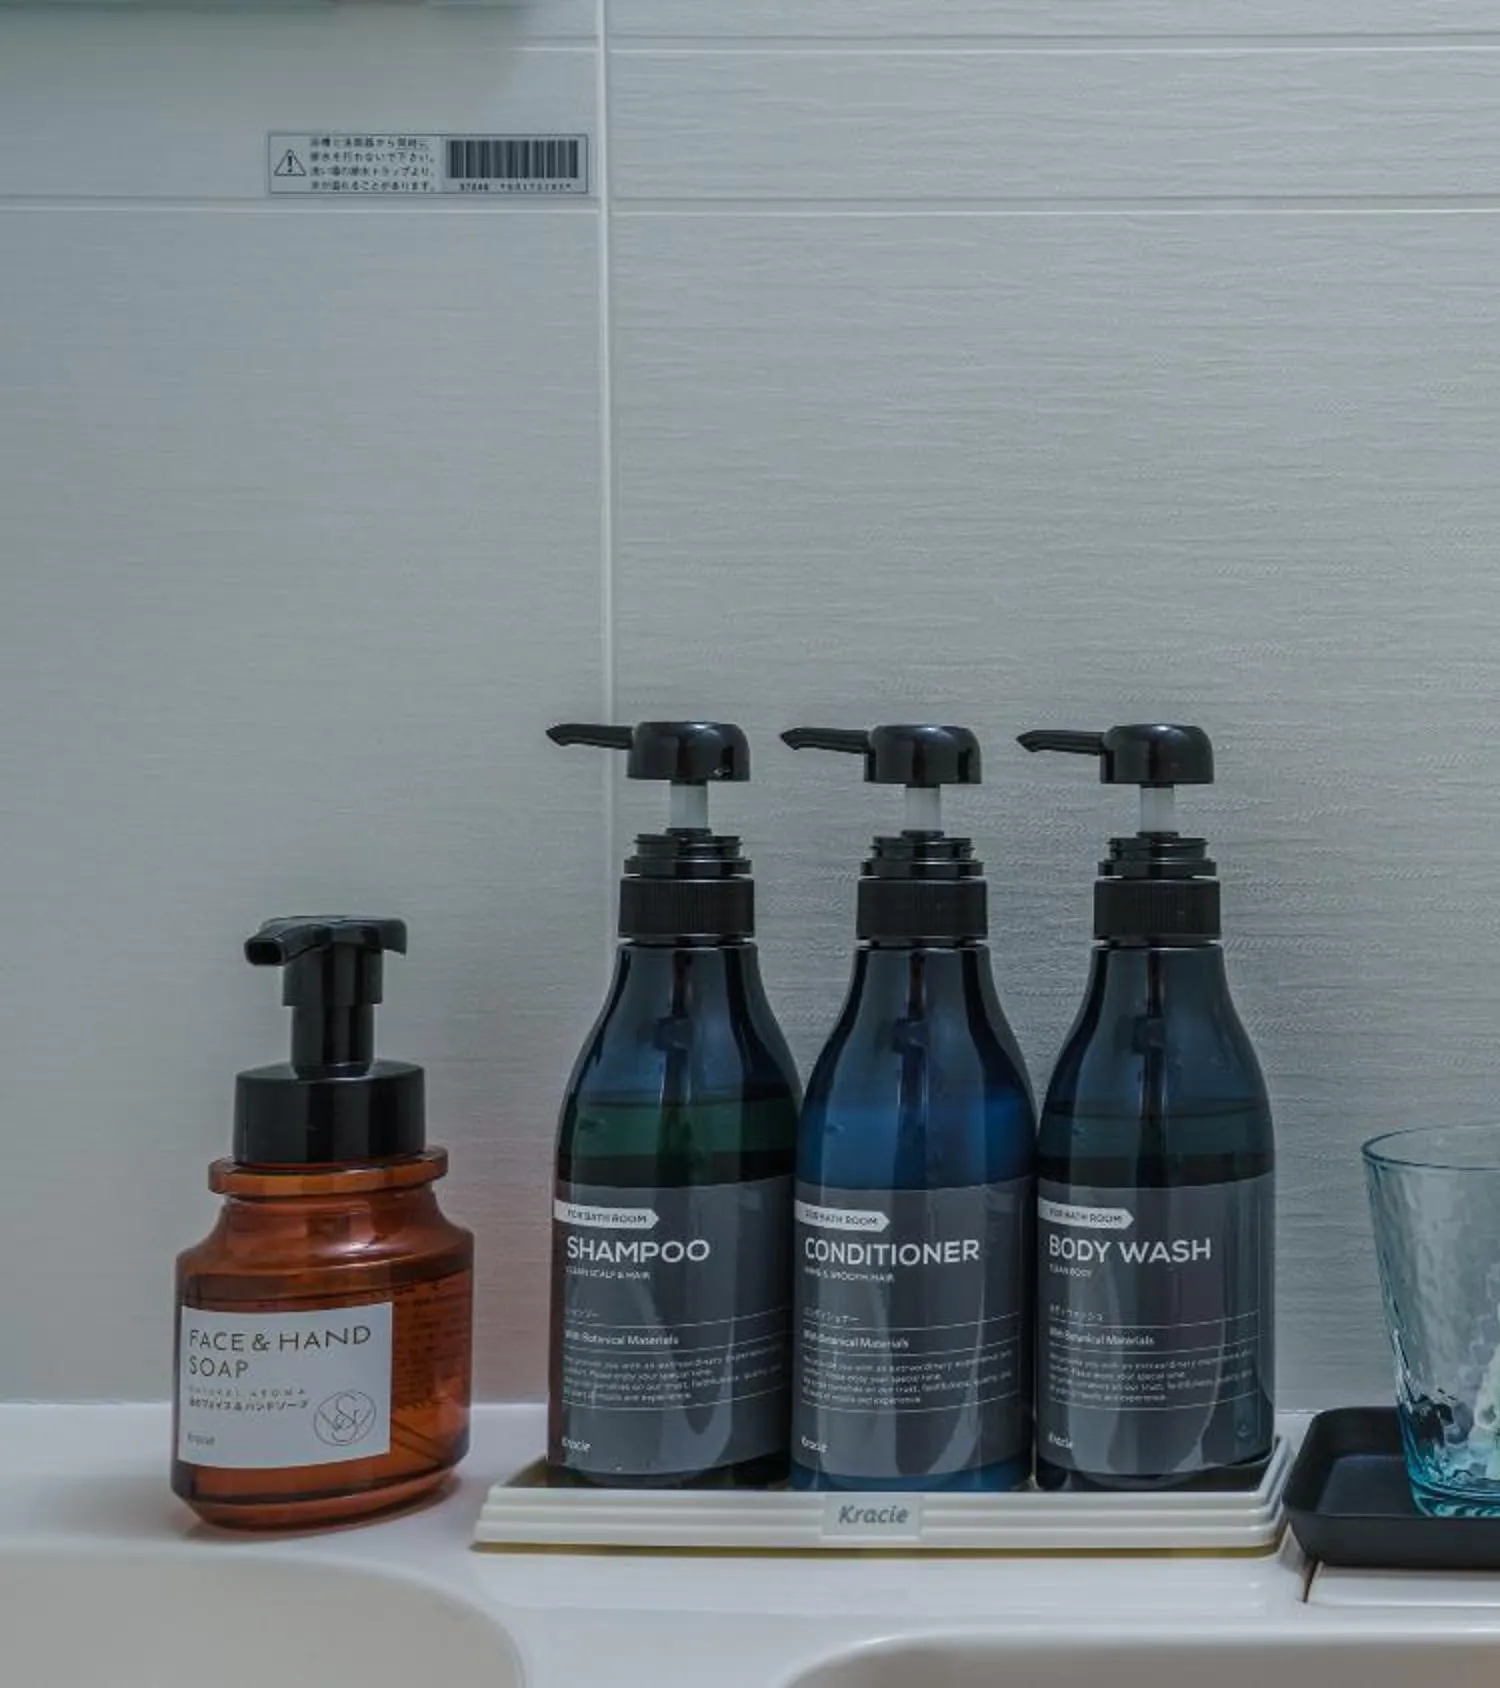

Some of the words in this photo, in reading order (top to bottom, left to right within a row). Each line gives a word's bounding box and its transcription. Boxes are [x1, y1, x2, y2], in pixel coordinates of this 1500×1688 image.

[567, 1236, 710, 1263] SHAMPOO
[805, 1237, 980, 1266] CONDITIONER
[1049, 1233, 1112, 1263] BODY
[1119, 1237, 1212, 1264] WASH
[188, 1354, 249, 1379] SOAP
[838, 1504, 909, 1524] Kracie
